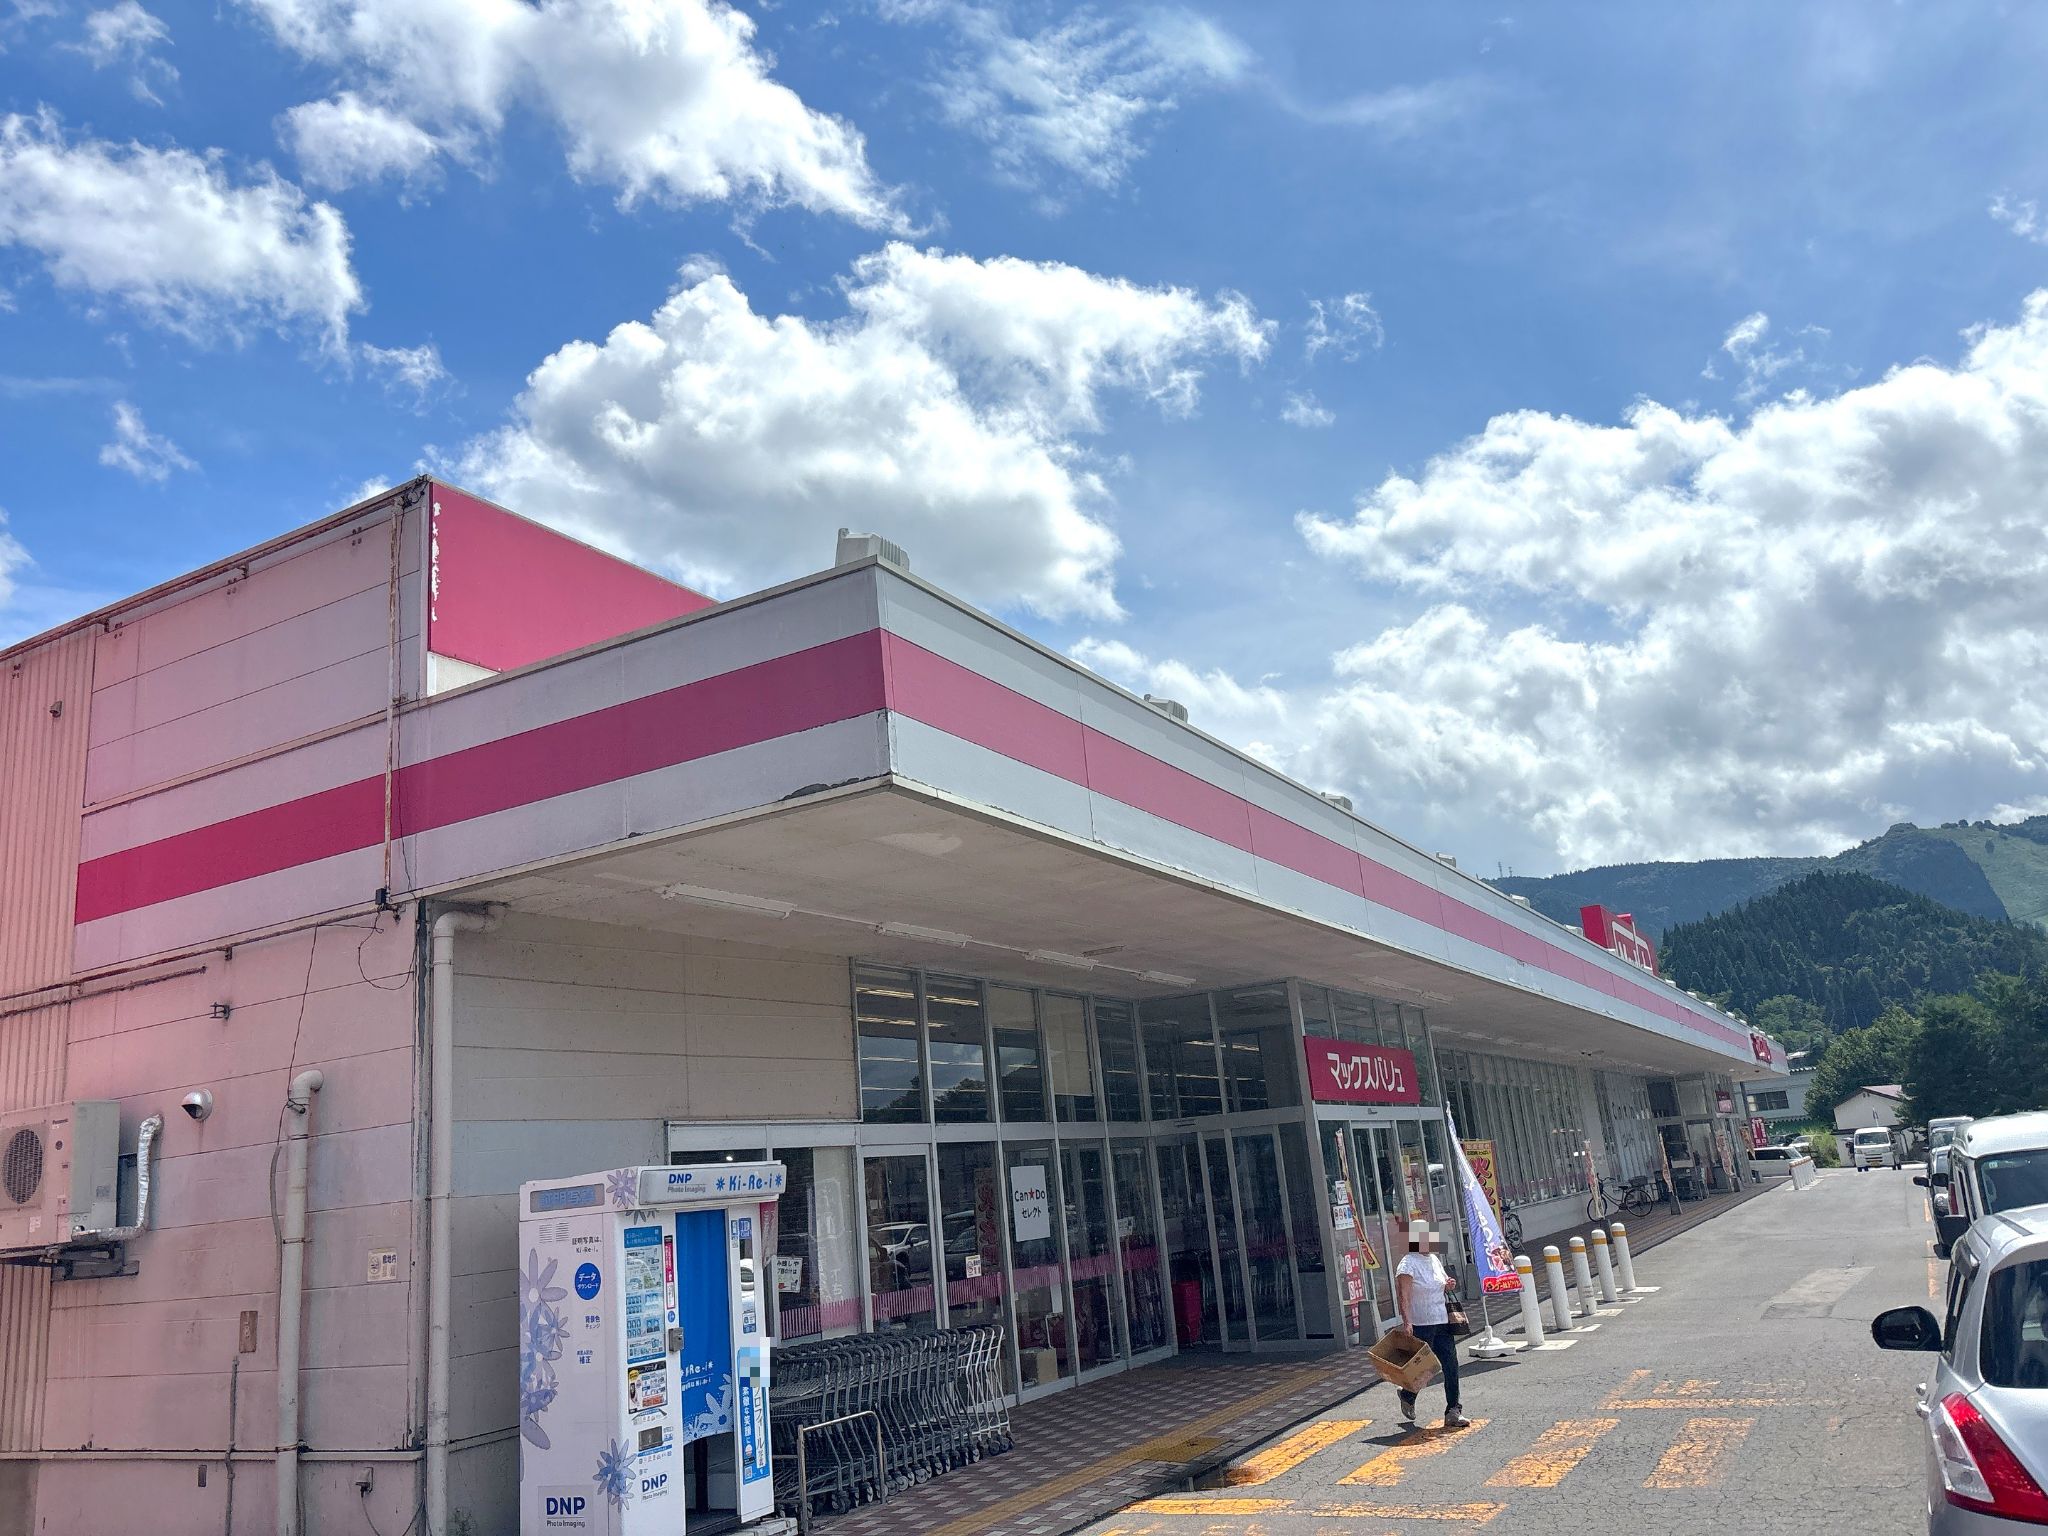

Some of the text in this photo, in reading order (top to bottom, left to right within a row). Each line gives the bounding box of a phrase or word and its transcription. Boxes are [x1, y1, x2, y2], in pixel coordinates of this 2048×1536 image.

[1326, 1052, 1406, 1093] マックスバリュ
[668, 1173, 693, 1184] DNP
[729, 1173, 773, 1191] Ki-Re-i
[685, 1185, 707, 1193] Imaging
[1022, 1206, 1042, 1219] セレクト
[578, 1272, 597, 1282] データ
[641, 1473, 668, 1492] DNP
[546, 1497, 586, 1515] DNP
[563, 1520, 586, 1528] Imaging
